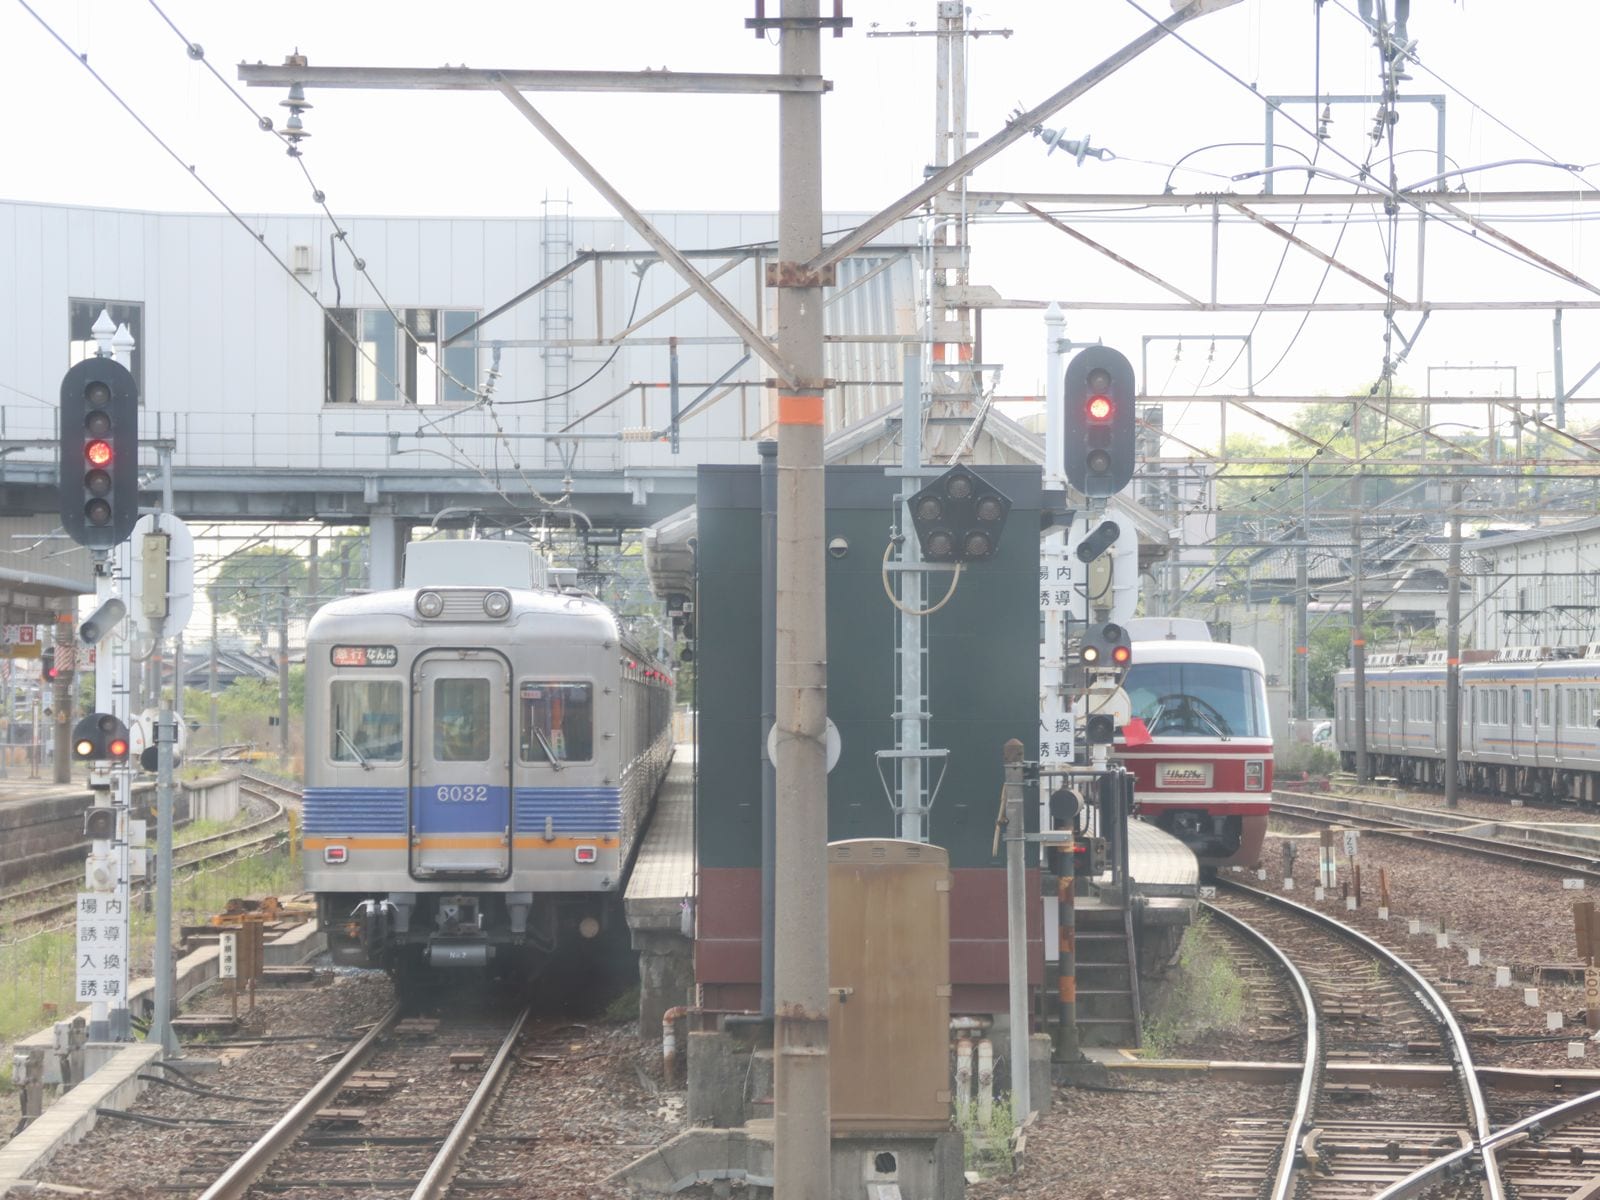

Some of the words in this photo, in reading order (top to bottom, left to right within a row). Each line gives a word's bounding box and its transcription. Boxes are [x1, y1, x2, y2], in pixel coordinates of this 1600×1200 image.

[437, 786, 488, 801] 6032
[81, 898, 122, 914] 場内
[81, 926, 120, 942] 誘導
[81, 954, 120, 970] 入換
[81, 980, 121, 997] 誘導
